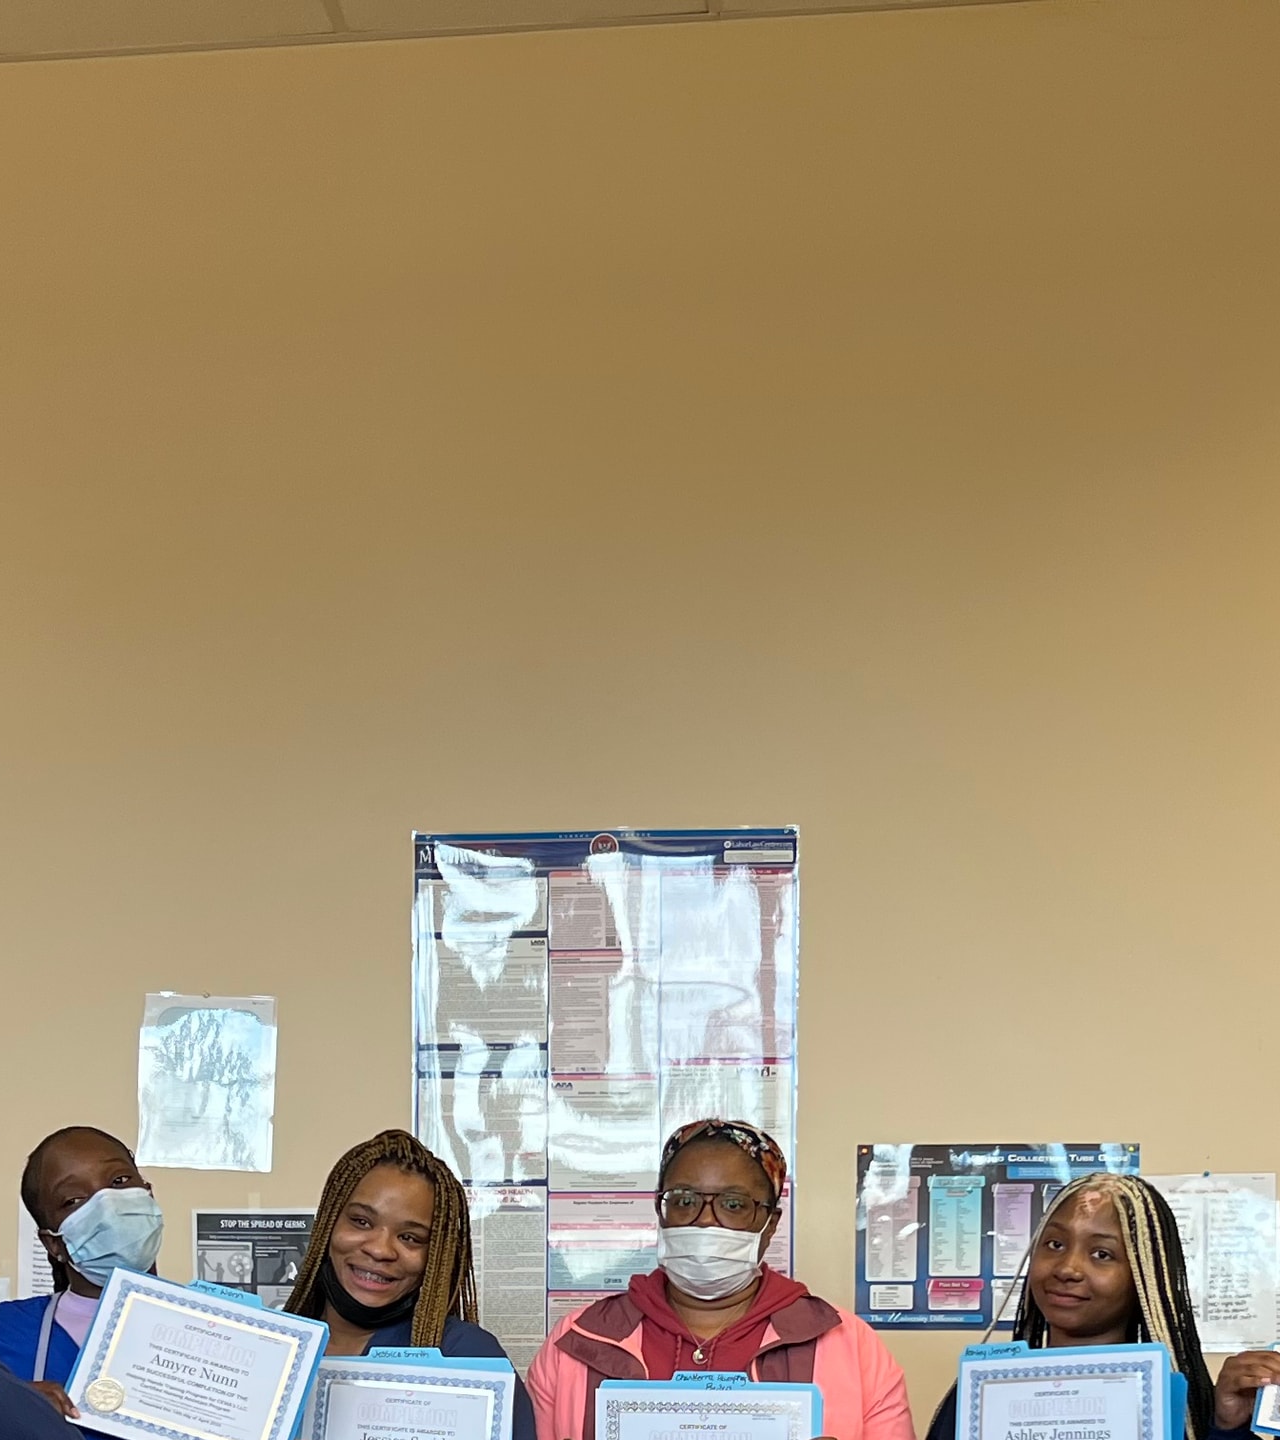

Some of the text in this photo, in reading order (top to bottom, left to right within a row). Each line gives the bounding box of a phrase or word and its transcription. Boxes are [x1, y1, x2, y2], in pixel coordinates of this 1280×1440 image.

[220, 1220, 306, 1228] STOP THE SPREAD OF GERMS
[149, 1354, 238, 1388] Amyre Nunn
